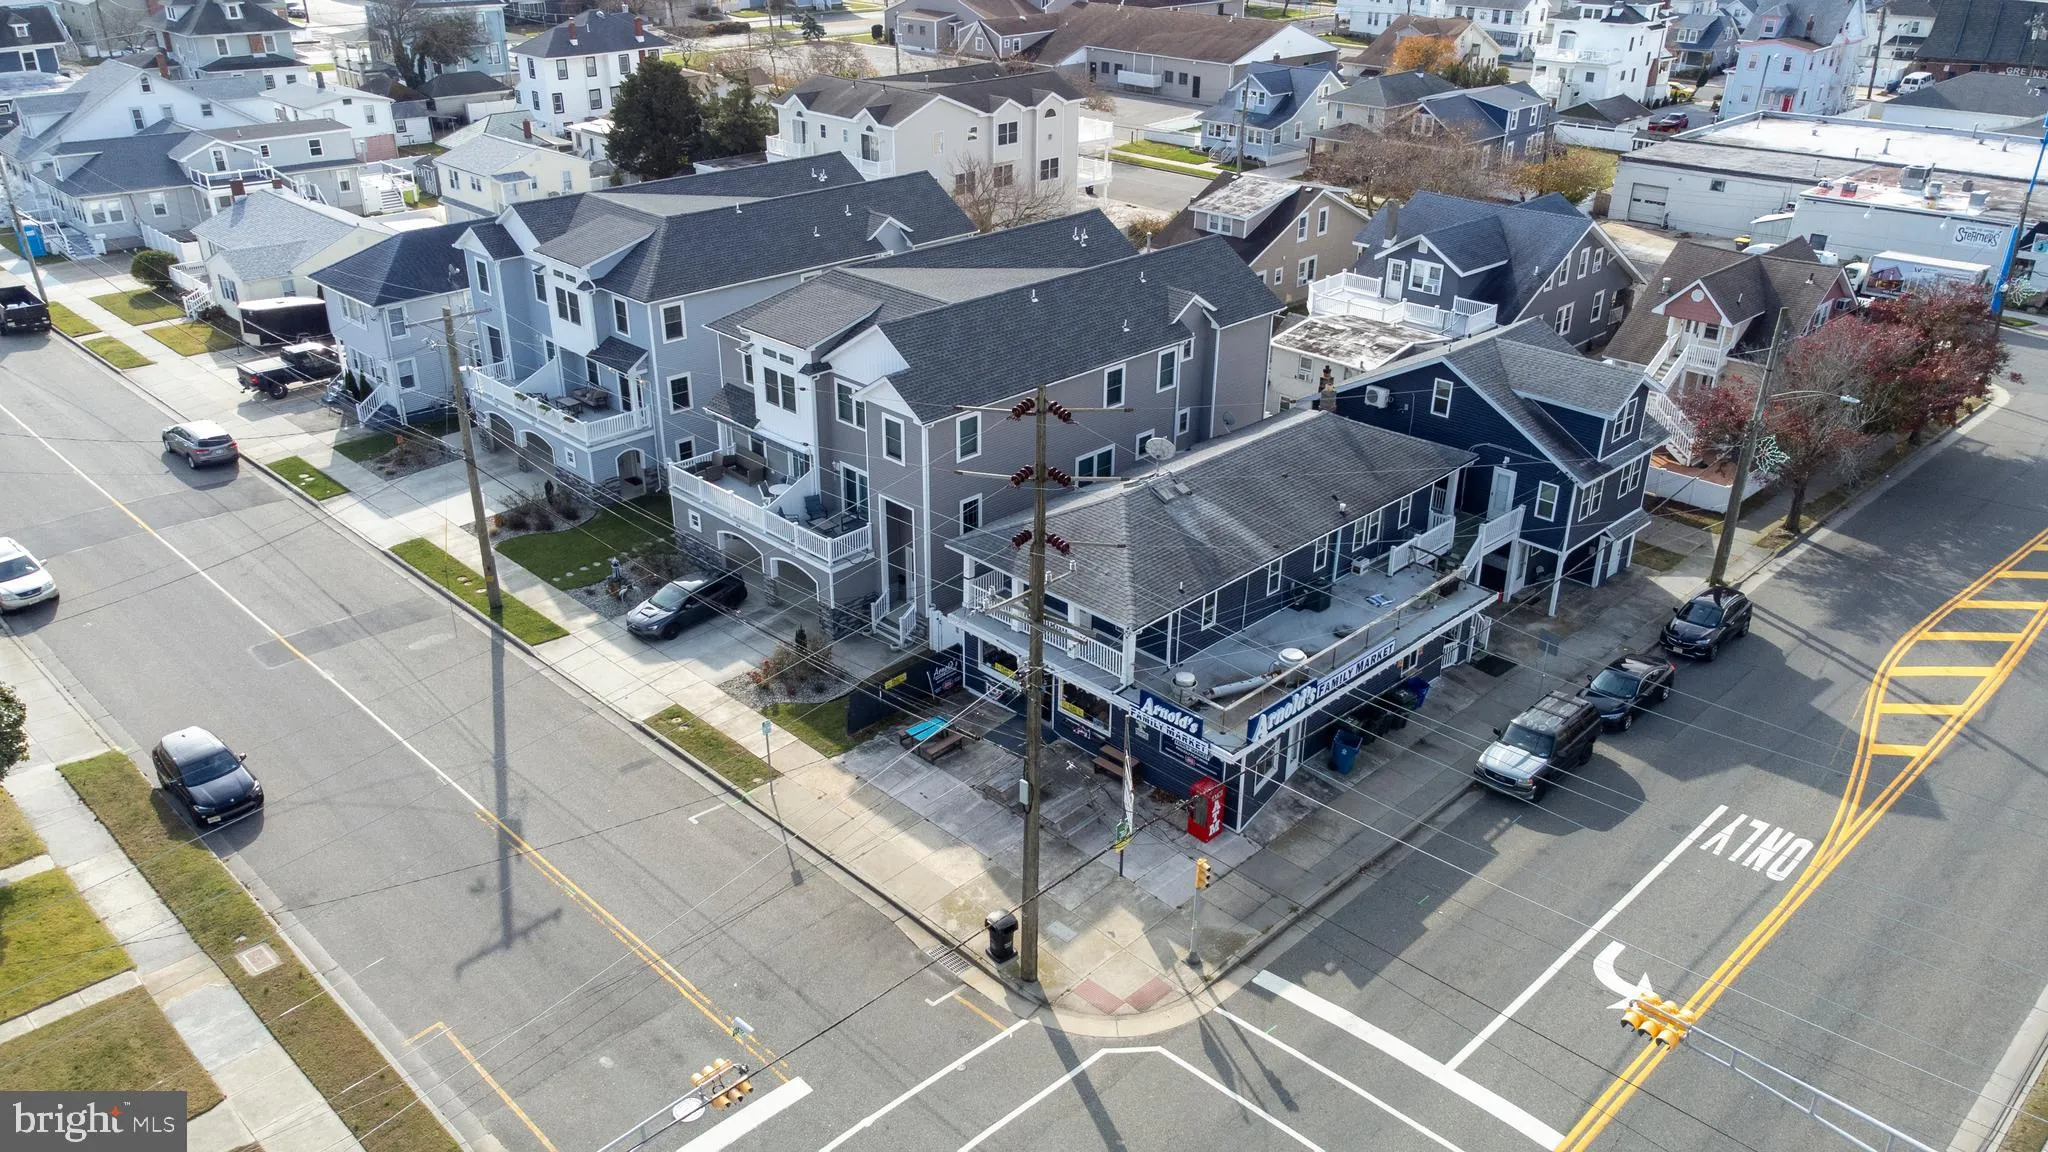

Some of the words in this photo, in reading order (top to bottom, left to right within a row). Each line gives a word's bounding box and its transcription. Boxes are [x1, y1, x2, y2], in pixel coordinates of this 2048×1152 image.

[1318, 666, 1356, 697] FAMILY
[1355, 644, 1394, 674] MARKET
[1129, 707, 1164, 730] FAMILY
[1166, 726, 1208, 752] MARKET
[1140, 697, 1199, 733] Arnold's
[1251, 686, 1317, 743] Arnold's
[1209, 800, 1221, 836] ATM
[1700, 813, 1814, 881] ONLY
